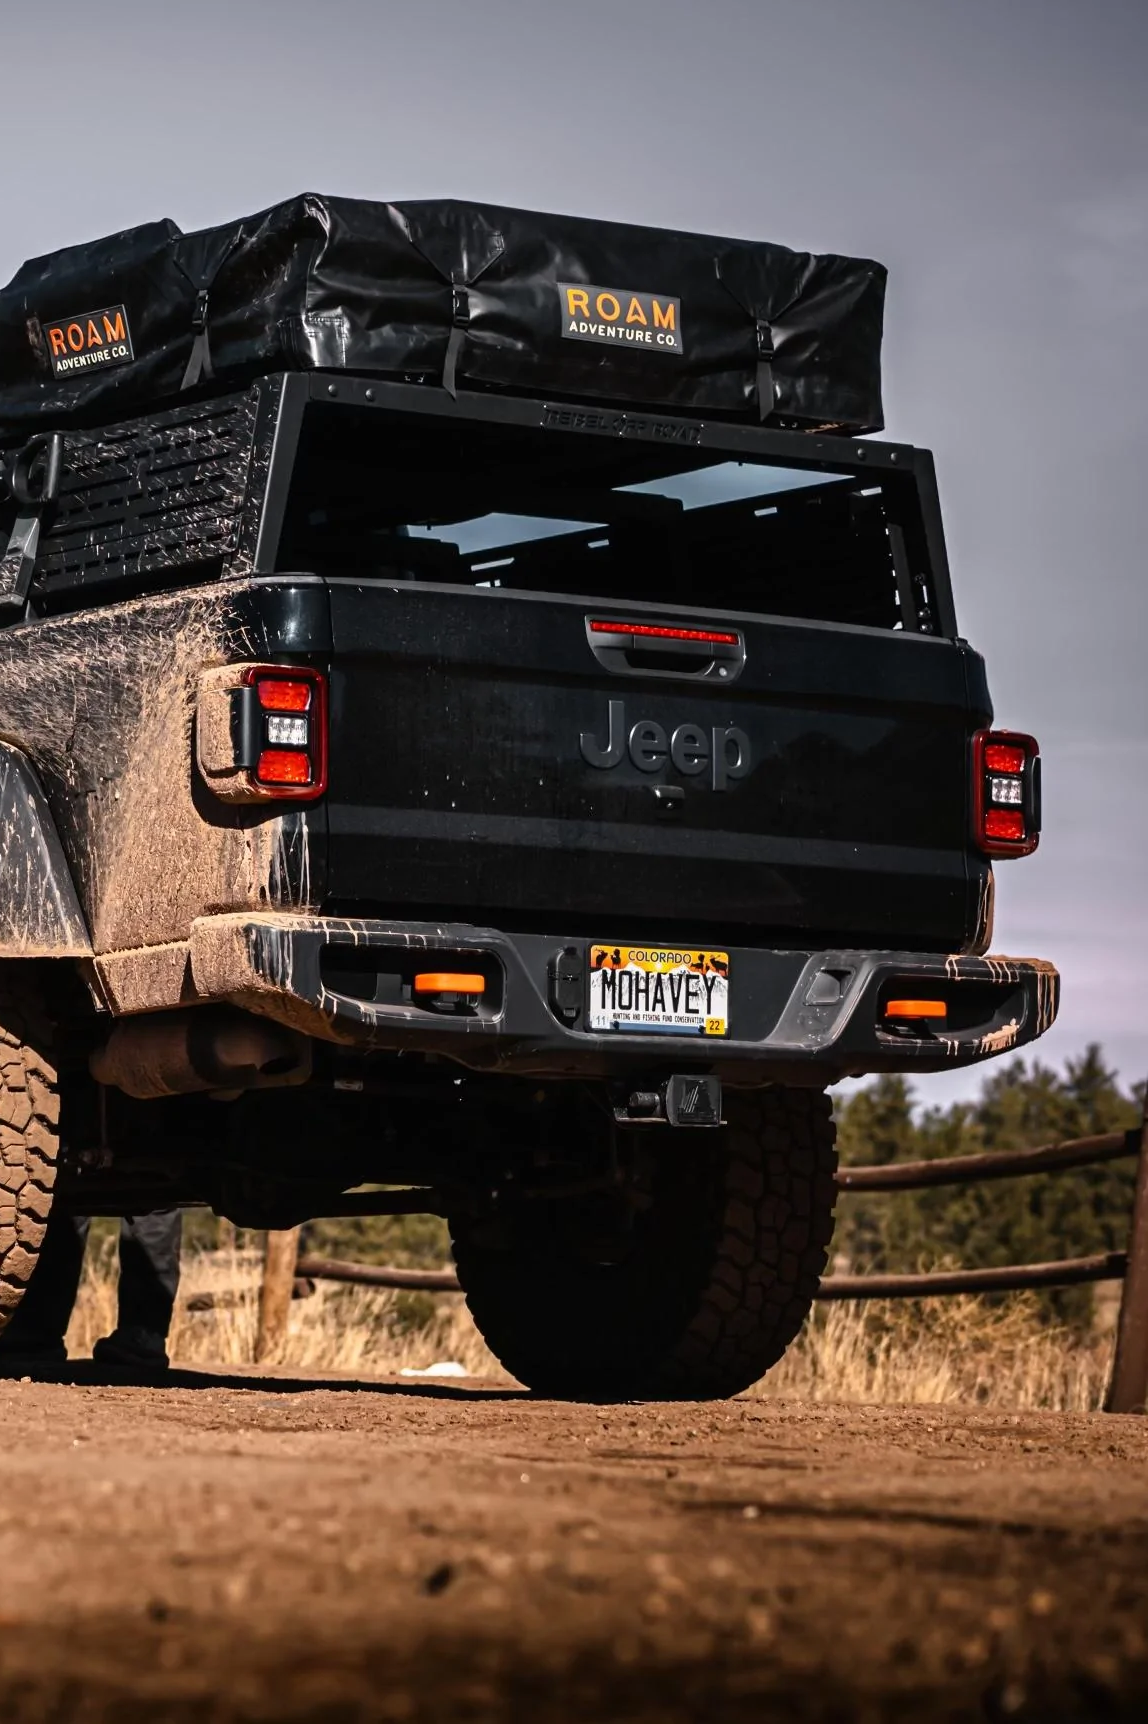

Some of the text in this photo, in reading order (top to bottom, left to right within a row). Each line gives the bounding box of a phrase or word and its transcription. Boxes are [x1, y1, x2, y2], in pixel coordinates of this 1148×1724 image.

[567, 288, 676, 331] ROAM
[49, 312, 126, 357] ROAM
[569, 320, 678, 347] ADVENTURE CO.
[56, 345, 129, 372] ADVENTURE CO.
[580, 700, 751, 791] Jeep
[628, 950, 692, 964] COLORADO
[601, 969, 717, 1015] MOHAVEY
[709, 1020, 720, 1031] 22
